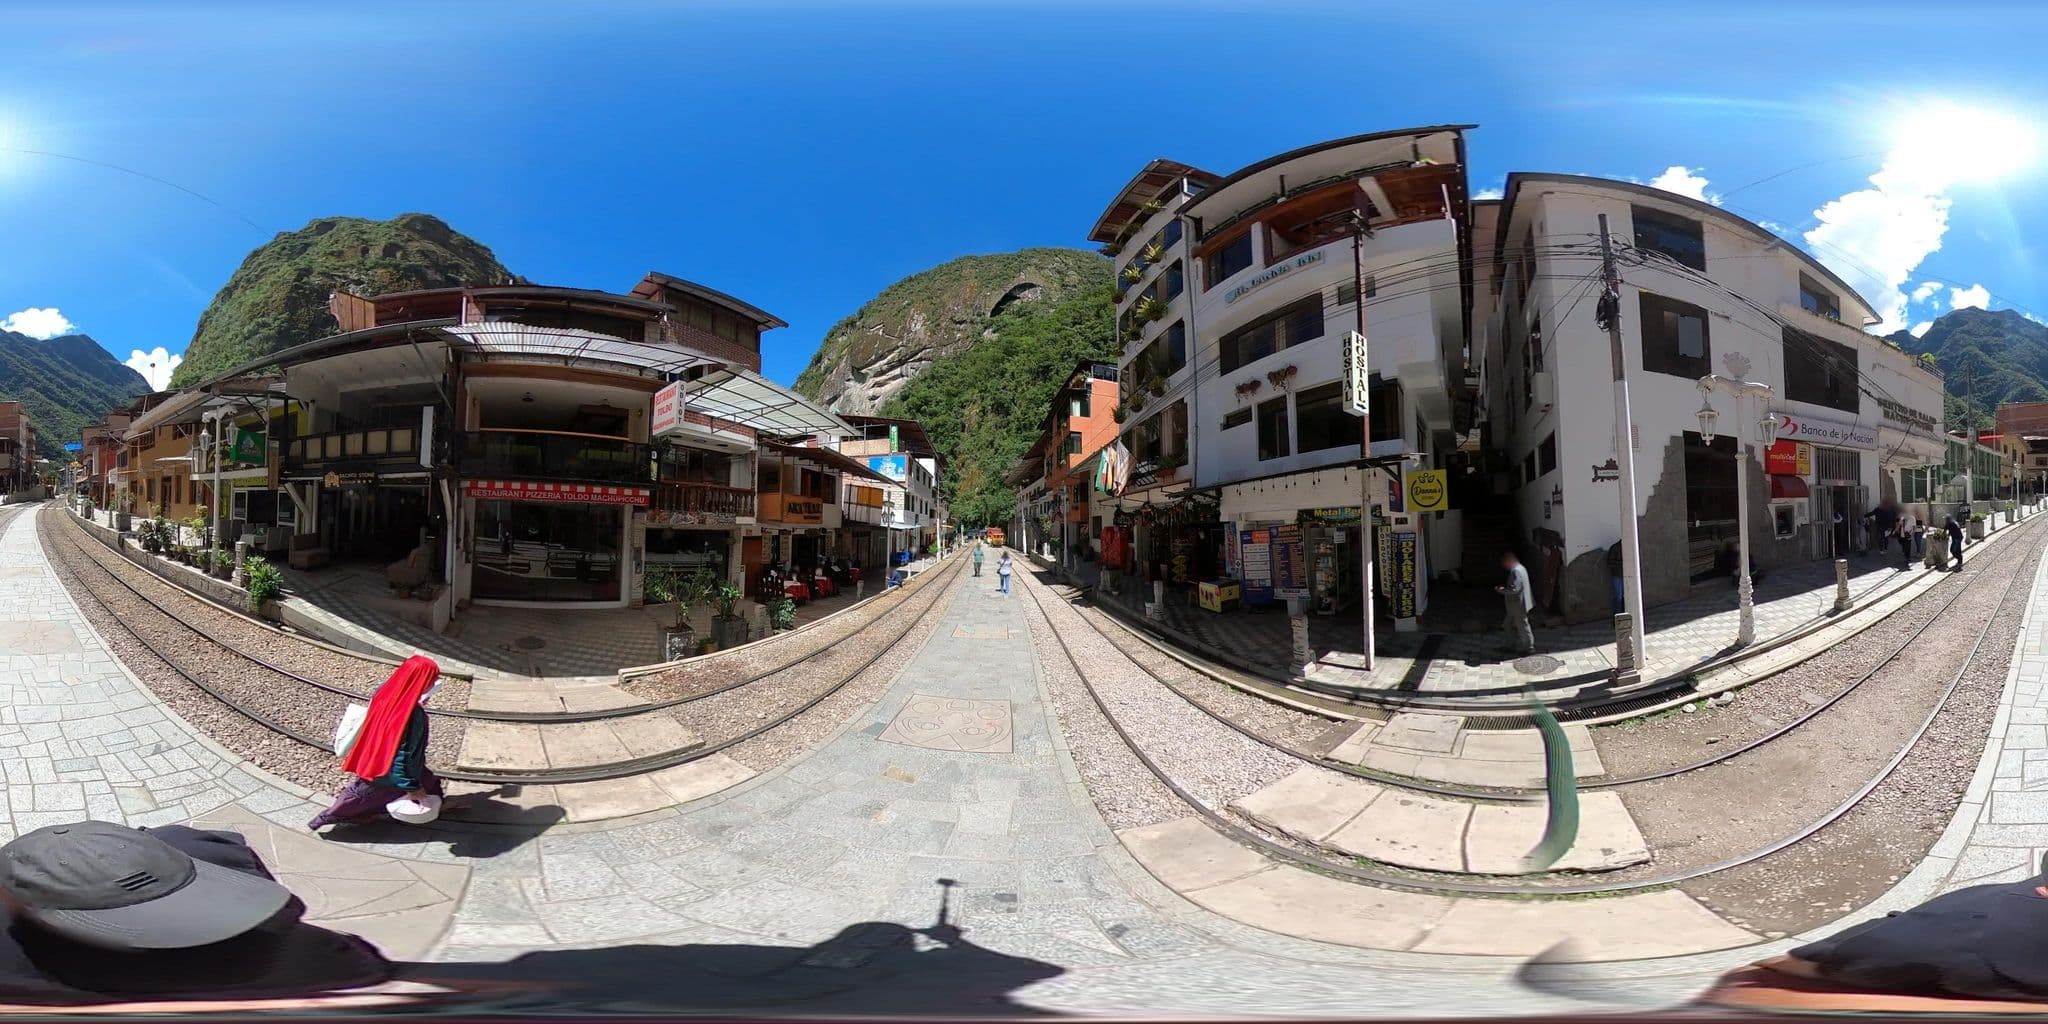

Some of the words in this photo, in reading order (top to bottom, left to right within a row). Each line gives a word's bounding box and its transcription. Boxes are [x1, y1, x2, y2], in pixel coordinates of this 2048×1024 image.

[1343, 336, 1352, 402] HOSTAL
[1355, 334, 1366, 403] HOSTAL
[1801, 423, 1828, 437] Banco
[1829, 428, 1839, 439] de
[1841, 431, 1849, 441] la
[1850, 431, 1874, 445] Nación
[471, 488, 524, 499] RESTAURANT
[525, 490, 561, 500] PIZZERIA
[563, 493, 590, 501] TOLDO
[590, 495, 645, 504] MACHUPICCHU
[1313, 507, 1342, 518] Metal
[1401, 541, 1414, 584] DOLARES
